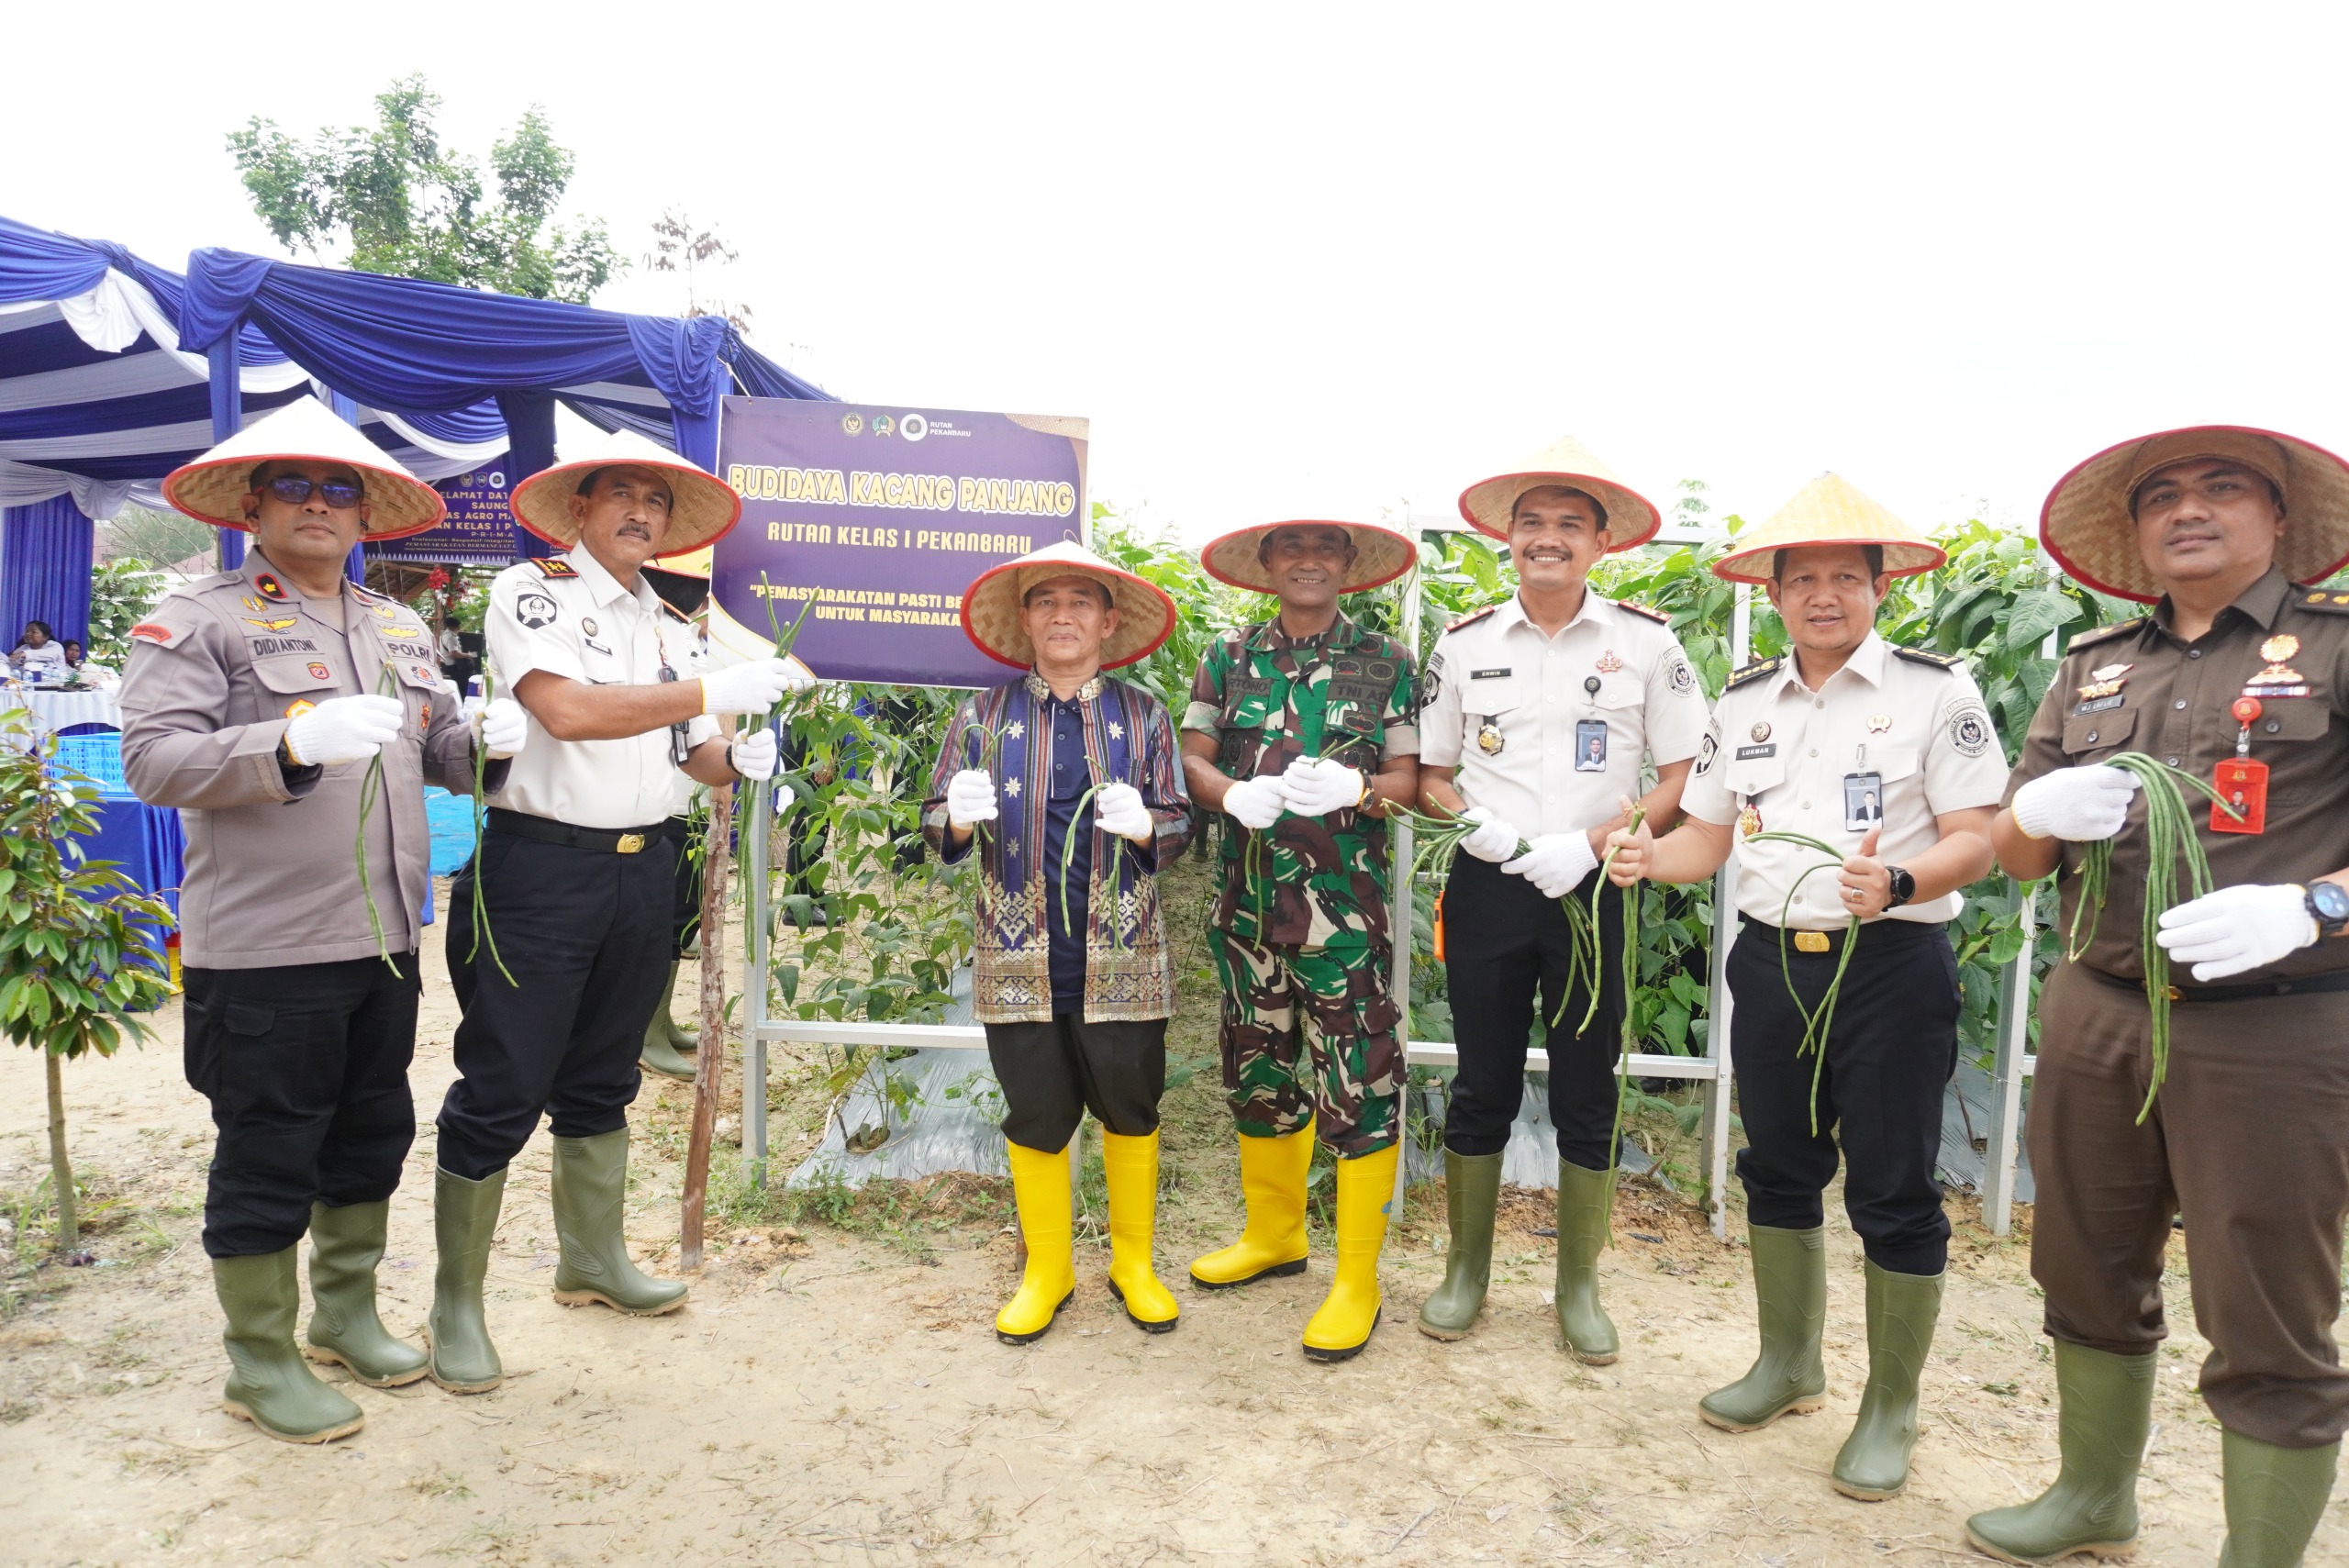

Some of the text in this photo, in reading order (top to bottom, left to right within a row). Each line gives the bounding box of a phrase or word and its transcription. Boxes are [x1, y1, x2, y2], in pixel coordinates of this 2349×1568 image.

[930, 428, 972, 437] PEKANBARU
[729, 465, 1074, 516] BUDIDAYA KACANG PANJANG
[464, 512, 494, 520] AGRO
[767, 521, 1031, 555] RUTAN KELAS I PEKANBARU
[898, 593, 941, 608] PASTI
[815, 606, 962, 627] UNTUK MASYARAKA
[386, 642, 431, 662] POLRI
[1337, 684, 1364, 698] TNI
[1742, 747, 1770, 756] LUKMAN
